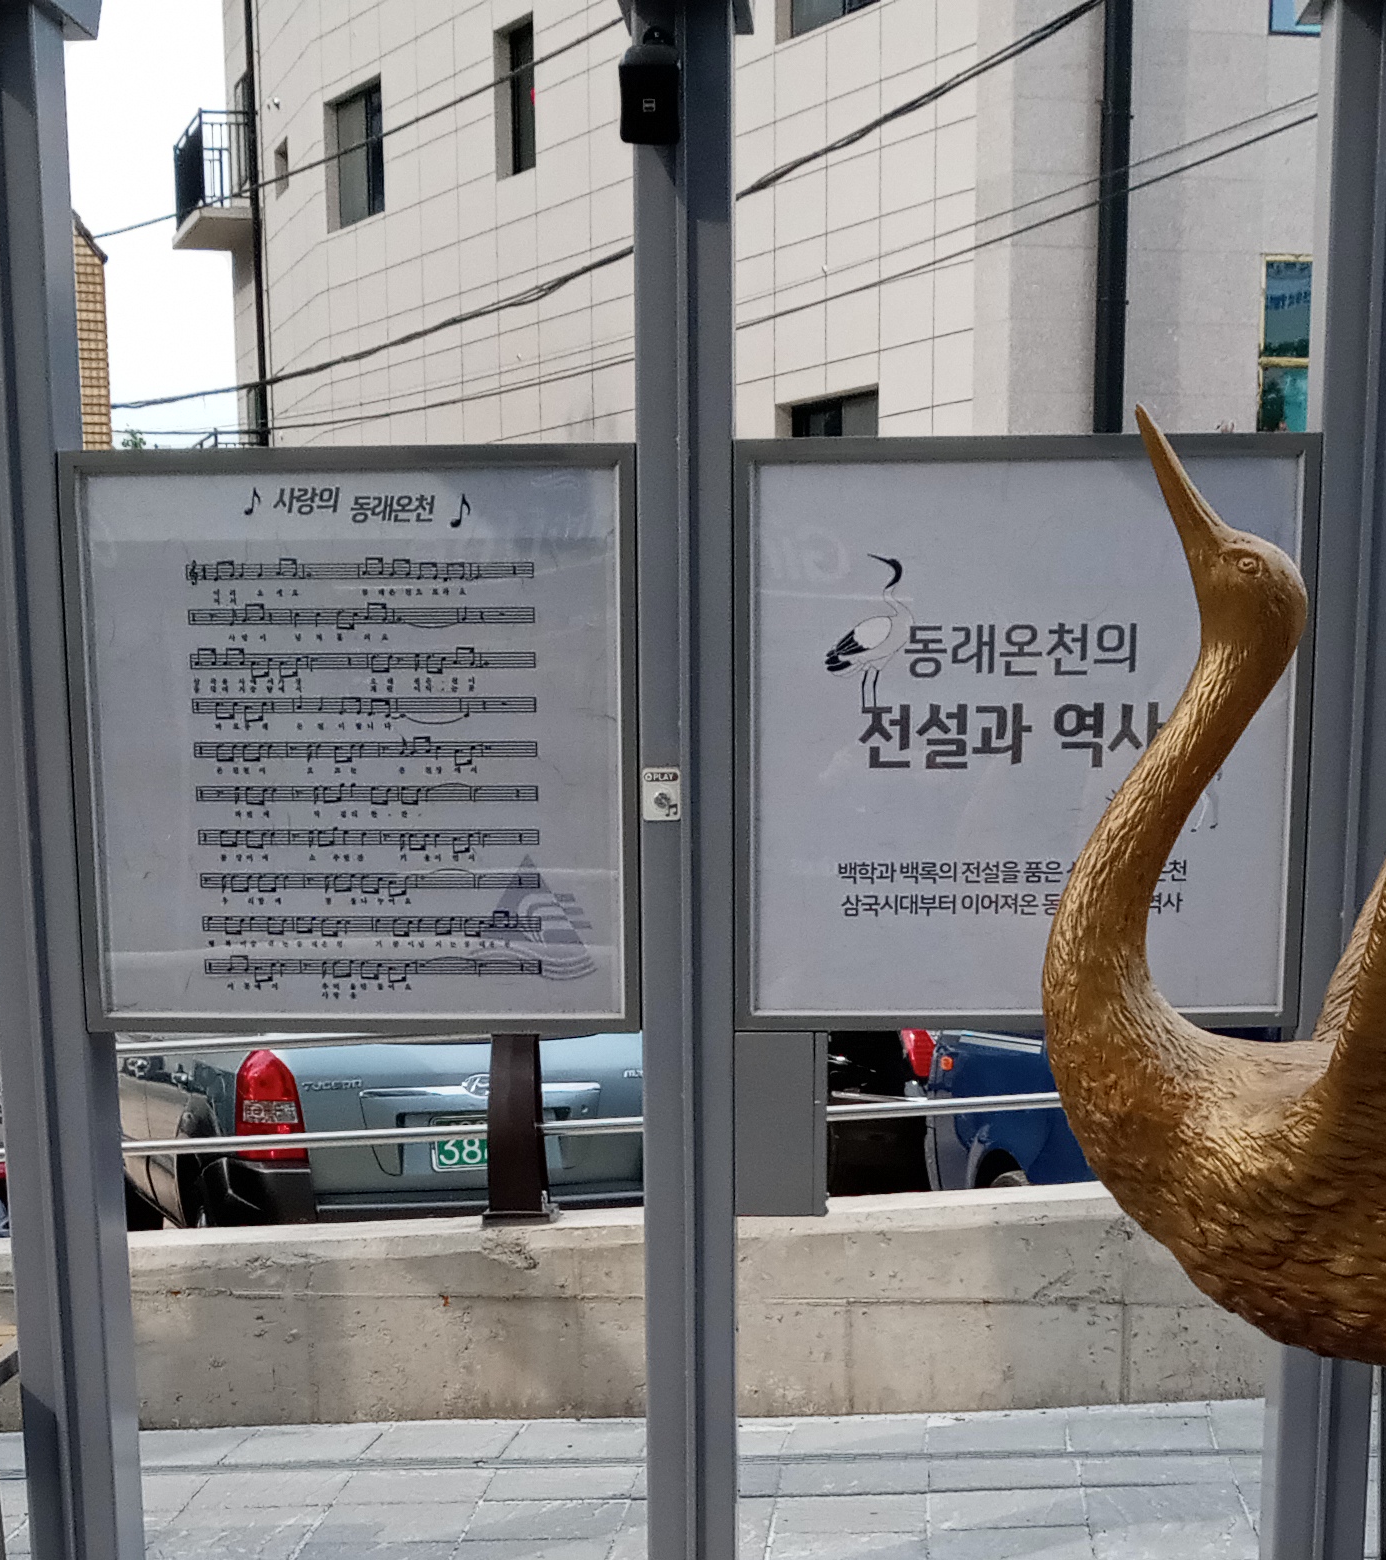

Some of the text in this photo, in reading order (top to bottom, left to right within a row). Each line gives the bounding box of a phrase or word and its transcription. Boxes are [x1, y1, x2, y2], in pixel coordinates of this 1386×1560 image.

[273, 486, 435, 523] 사랑의 동래온천
[904, 622, 1137, 678] 동래온천의
[859, 702, 1166, 769] 전설과 역사
[653, 773, 674, 781] PLAY
[838, 861, 896, 884] 백학과
[899, 861, 958, 884] 백록의
[961, 860, 1021, 884] 전설을
[1023, 860, 1063, 883] 품은
[841, 893, 956, 917] 삼국시대부터
[961, 894, 1039, 916] 이어져온
